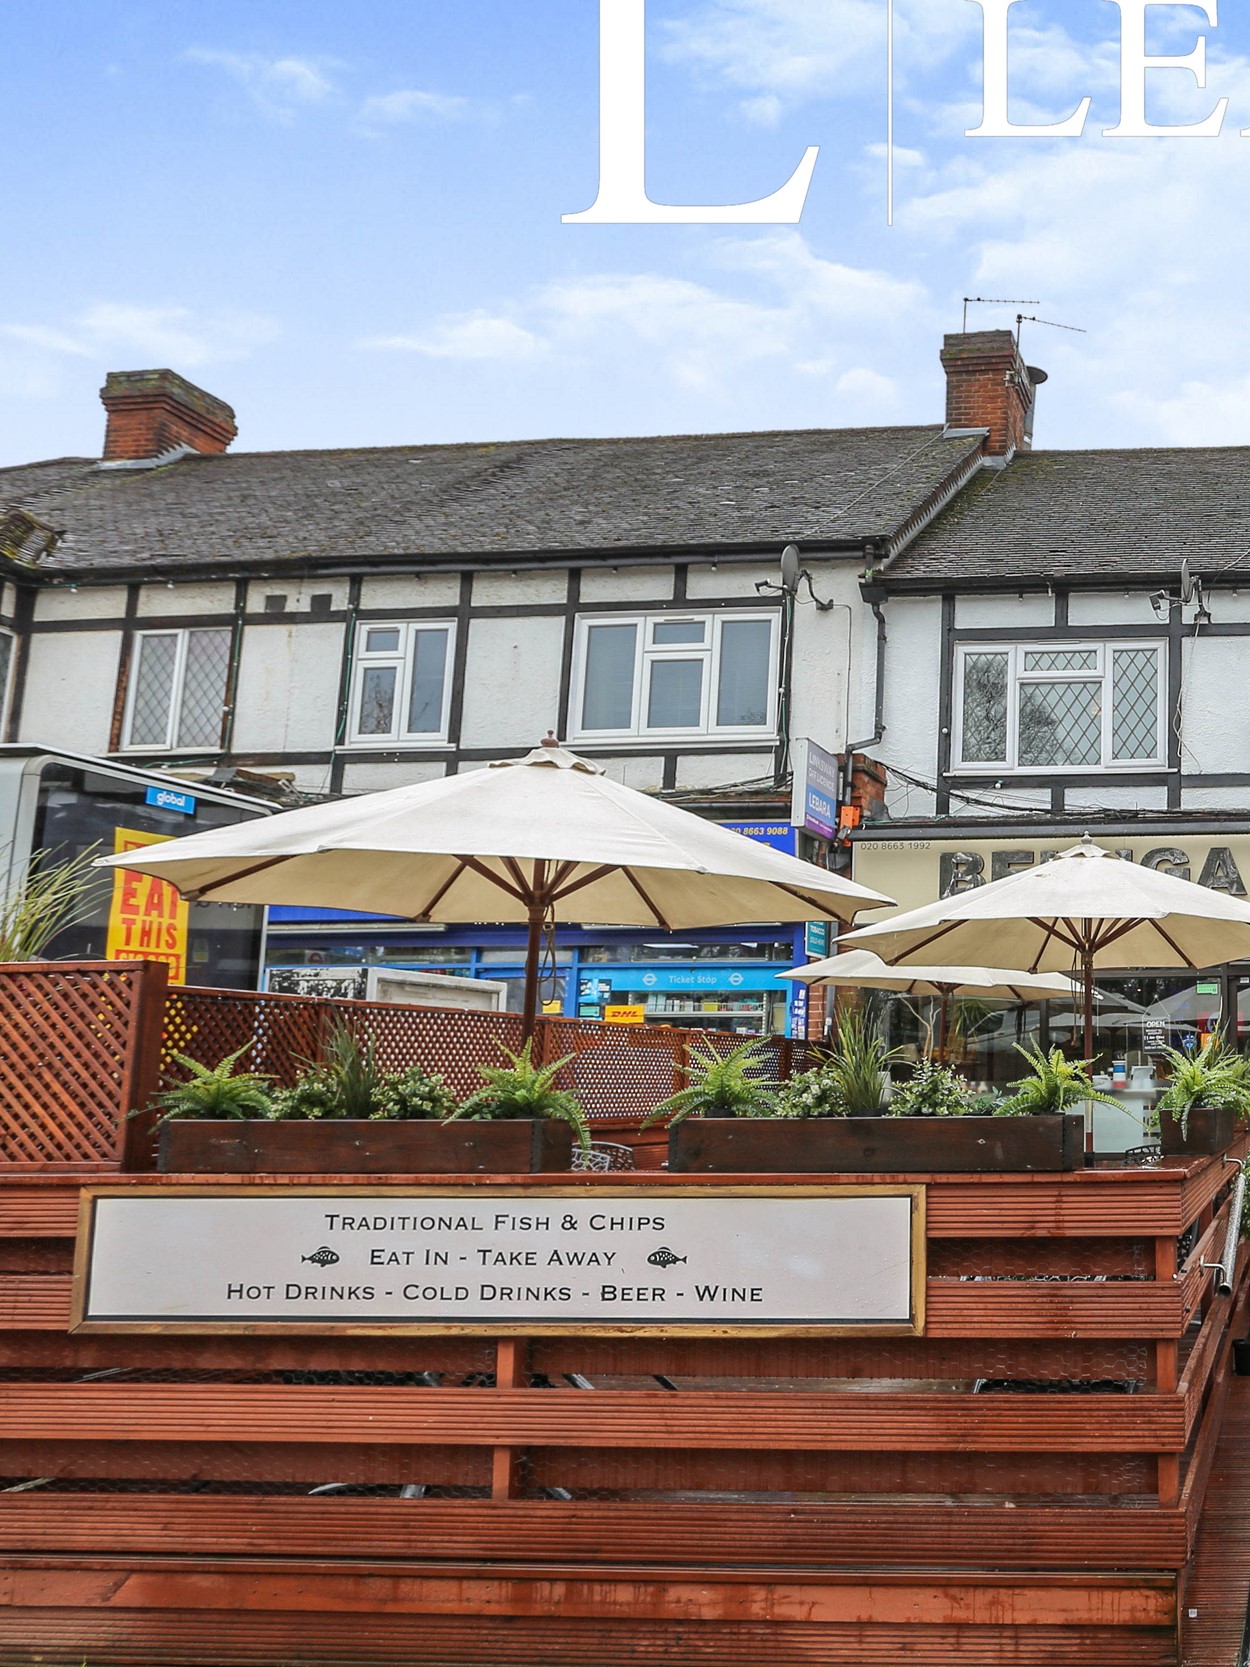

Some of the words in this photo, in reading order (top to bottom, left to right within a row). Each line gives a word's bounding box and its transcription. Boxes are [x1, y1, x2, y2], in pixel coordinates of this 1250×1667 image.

[156, 791, 185, 806] global
[808, 792, 831, 818] LEBARA
[743, 827, 764, 835] 8663
[767, 827, 788, 835] 9088
[860, 842, 878, 850] 020
[881, 842, 904, 850] 8663
[908, 842, 931, 850] 1992
[121, 917, 178, 950] THIS
[668, 975, 695, 984] Ticket
[697, 975, 717, 985] Stop
[610, 1010, 639, 1018] DHL
[324, 1213, 484, 1231] TRADITIONAL
[494, 1213, 550, 1231] FISH
[560, 1214, 578, 1231] &
[589, 1214, 666, 1231] CHIPS
[369, 1248, 415, 1266] EAT
[424, 1249, 449, 1266] IN
[477, 1249, 538, 1266] TAKE
[547, 1249, 617, 1266] AWAY
[226, 1283, 276, 1300] HOT
[284, 1283, 376, 1300] DRINKS
[402, 1284, 470, 1301] COLD
[479, 1284, 572, 1301] DRINKS
[600, 1285, 667, 1302] BEER
[695, 1285, 764, 1302] WINE
